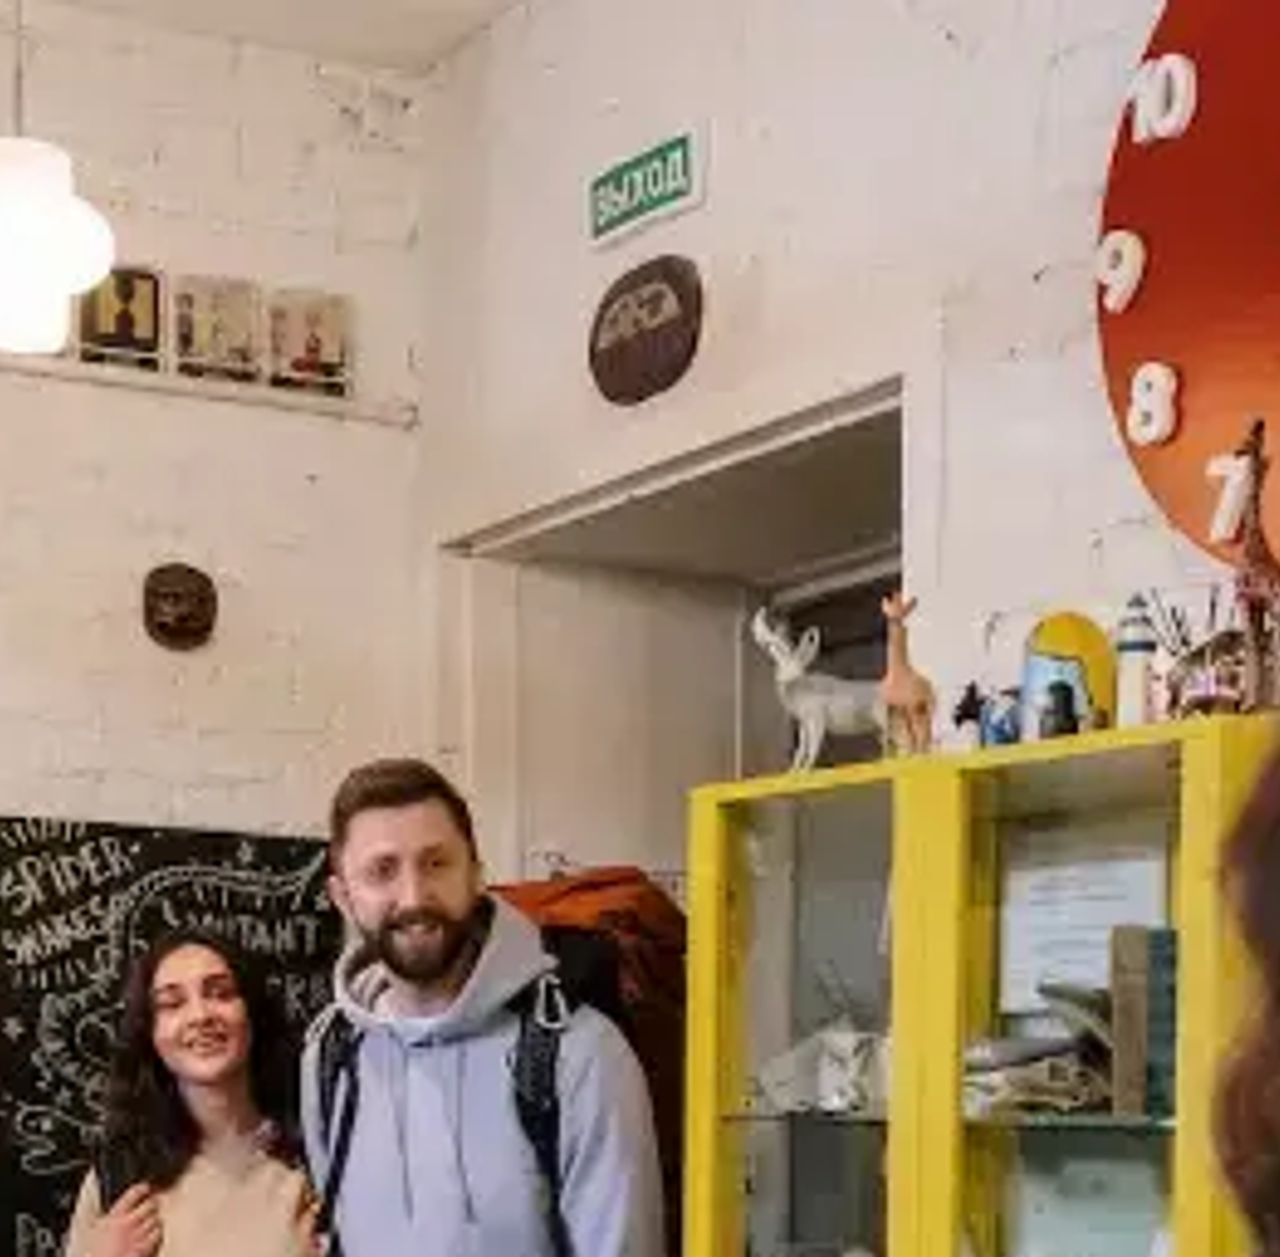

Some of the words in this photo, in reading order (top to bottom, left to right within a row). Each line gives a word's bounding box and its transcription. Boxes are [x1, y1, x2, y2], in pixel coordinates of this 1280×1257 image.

[1128, 53, 1197, 144] 10
[596, 146, 688, 228] ВЫХОД
[1099, 229, 1146, 313] 9
[1128, 361, 1178, 446] 8
[1205, 454, 1252, 543] 7
